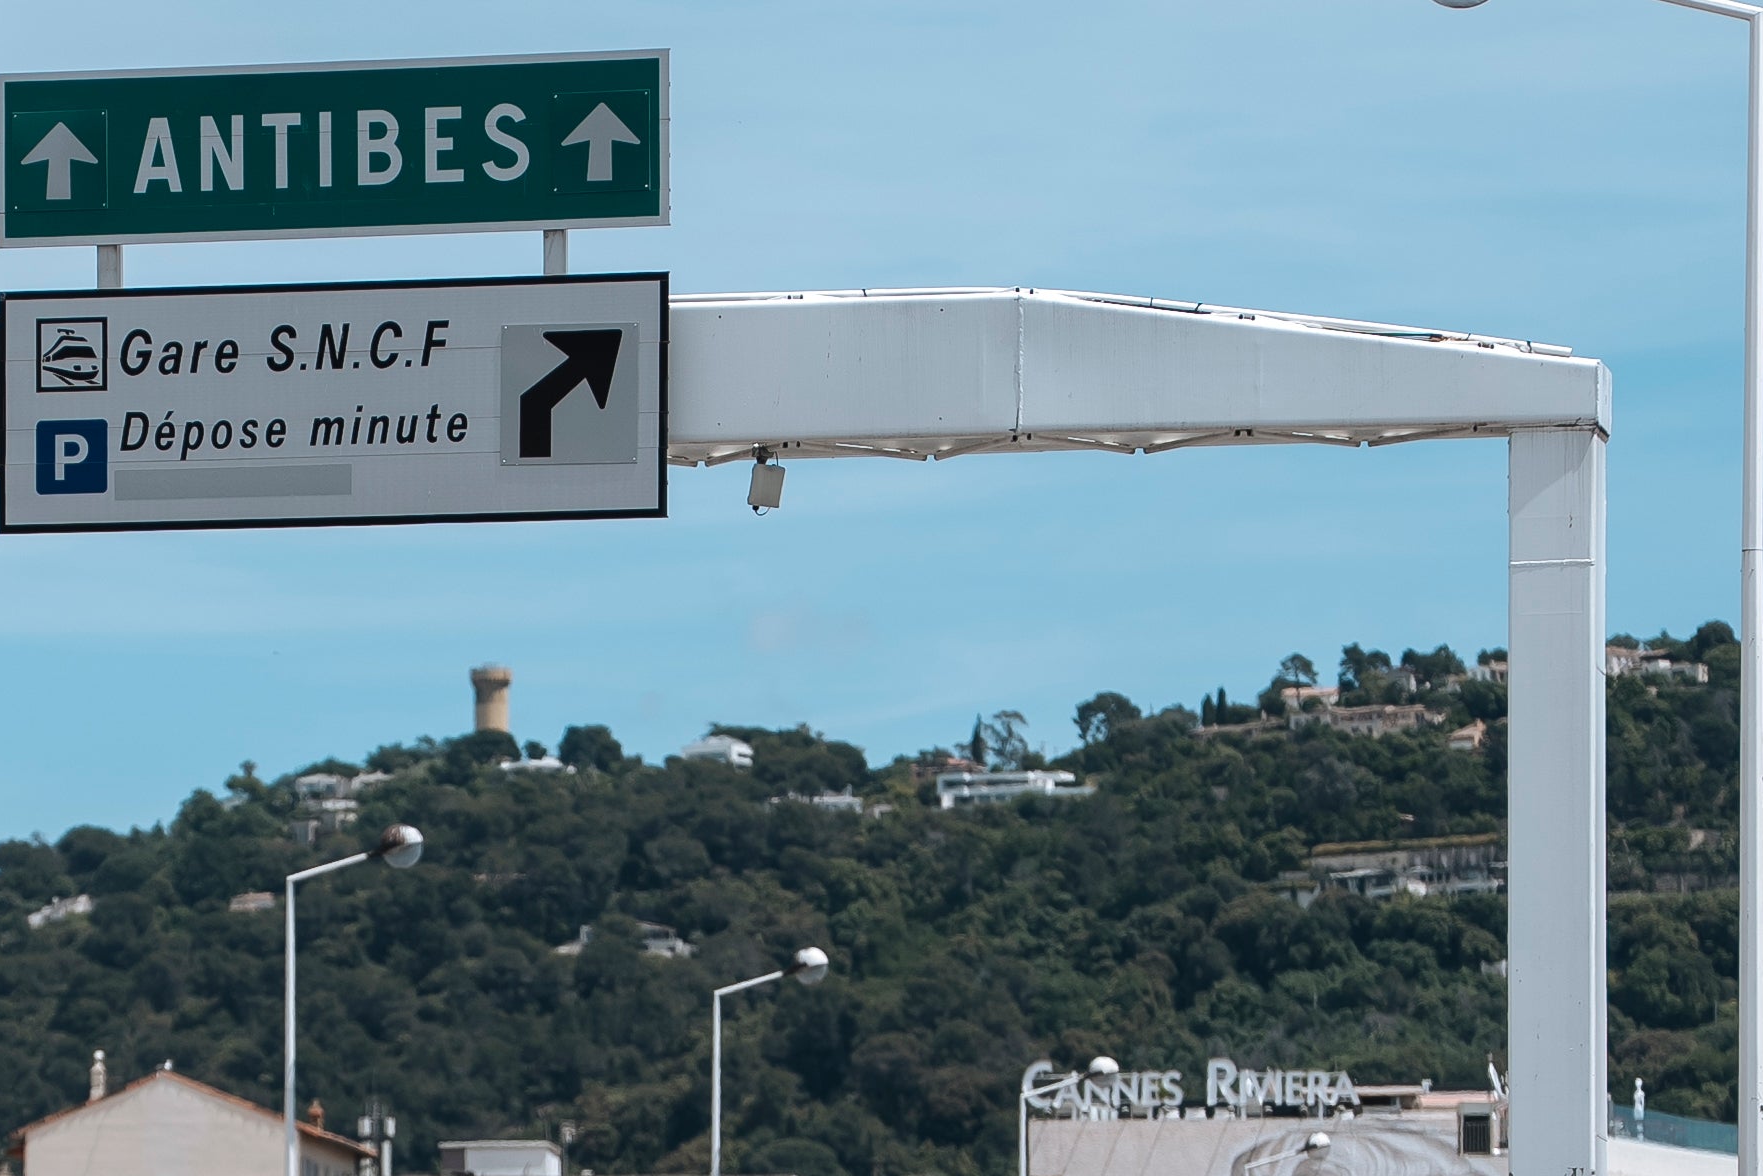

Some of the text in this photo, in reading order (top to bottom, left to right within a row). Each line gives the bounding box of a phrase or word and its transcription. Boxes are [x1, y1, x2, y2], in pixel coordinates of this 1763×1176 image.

[134, 103, 530, 193] ANTIBES
[120, 320, 450, 375] Gare S.N.C.F
[55, 433, 89, 481] P
[120, 403, 469, 460] Dépose minute
[1022, 1060, 1184, 1109] CANNES
